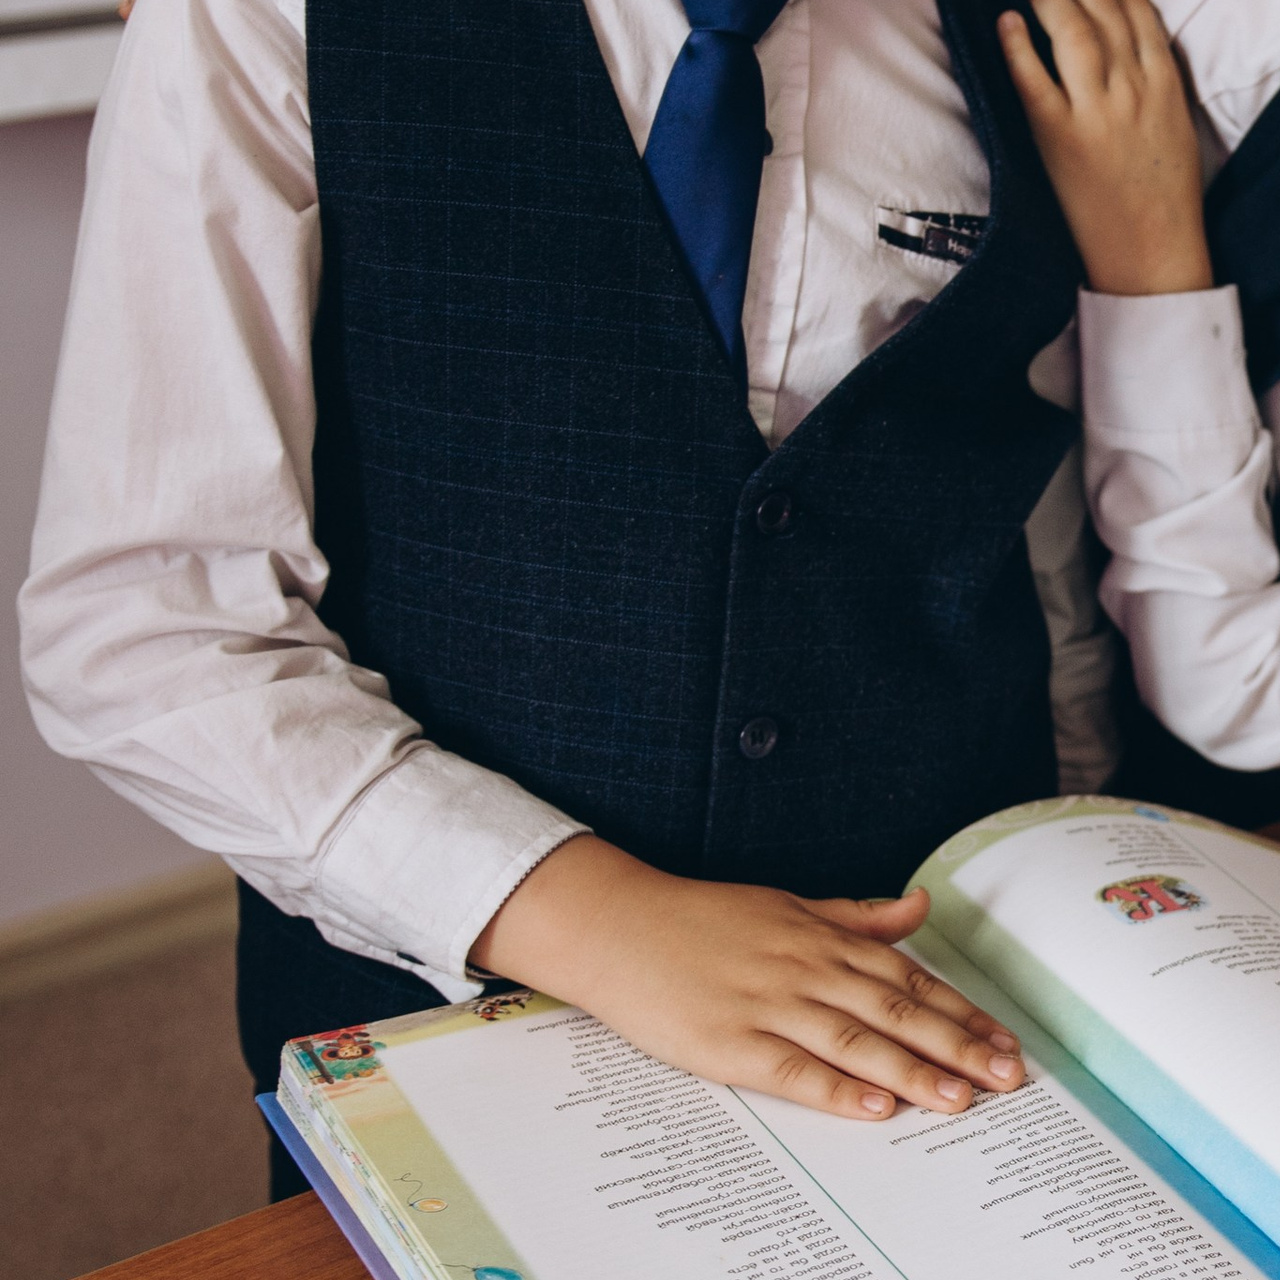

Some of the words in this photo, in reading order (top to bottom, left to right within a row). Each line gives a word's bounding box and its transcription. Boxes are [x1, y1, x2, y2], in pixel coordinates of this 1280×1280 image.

[1104, 880, 1190, 921] К
[985, 1094, 1053, 1122] карегла́зый
[1007, 1109, 1070, 1134] капремо́нт
[1043, 1117, 1078, 1131] ка́пля
[1017, 1125, 1087, 1151] канцтова́ры
[1025, 1129, 1040, 1137] за
[979, 1136, 1022, 1155] ка́плей
[1018, 1149, 1112, 1182] канавокопа́тель
[979, 1157, 1121, 1210] камнеобраба́тывающий
[1075, 1173, 1139, 1196] каменотёс
[1041, 1182, 1148, 1221] каменноу́гольный
[1134, 1213, 1151, 1221] по
[1153, 1207, 1175, 1216] как
[1072, 1219, 1131, 1244] пи́саному
[1158, 1224, 1194, 1238] како́й
[1136, 1234, 1156, 1243] бы
[1168, 1233, 1203, 1245] како́в
[1118, 1241, 1134, 1250] то
[1146, 1243, 1166, 1252] бы
[1191, 1242, 1213, 1251] как
[1097, 1248, 1114, 1258] ни́
[1126, 1249, 1143, 1260] ни́
[1171, 1247, 1189, 1256] ни
[1200, 1251, 1223, 1260] как
[1068, 1256, 1095, 1269] был
[1151, 1253, 1169, 1262] на
[1181, 1256, 1198, 1265] ни
[1120, 1260, 1149, 1272] есть
[1190, 1266, 1208, 1274] ни
[1210, 1260, 1232, 1269] как
[1133, 1262, 1178, 1280] говори́
[1219, 1269, 1242, 1278] как
